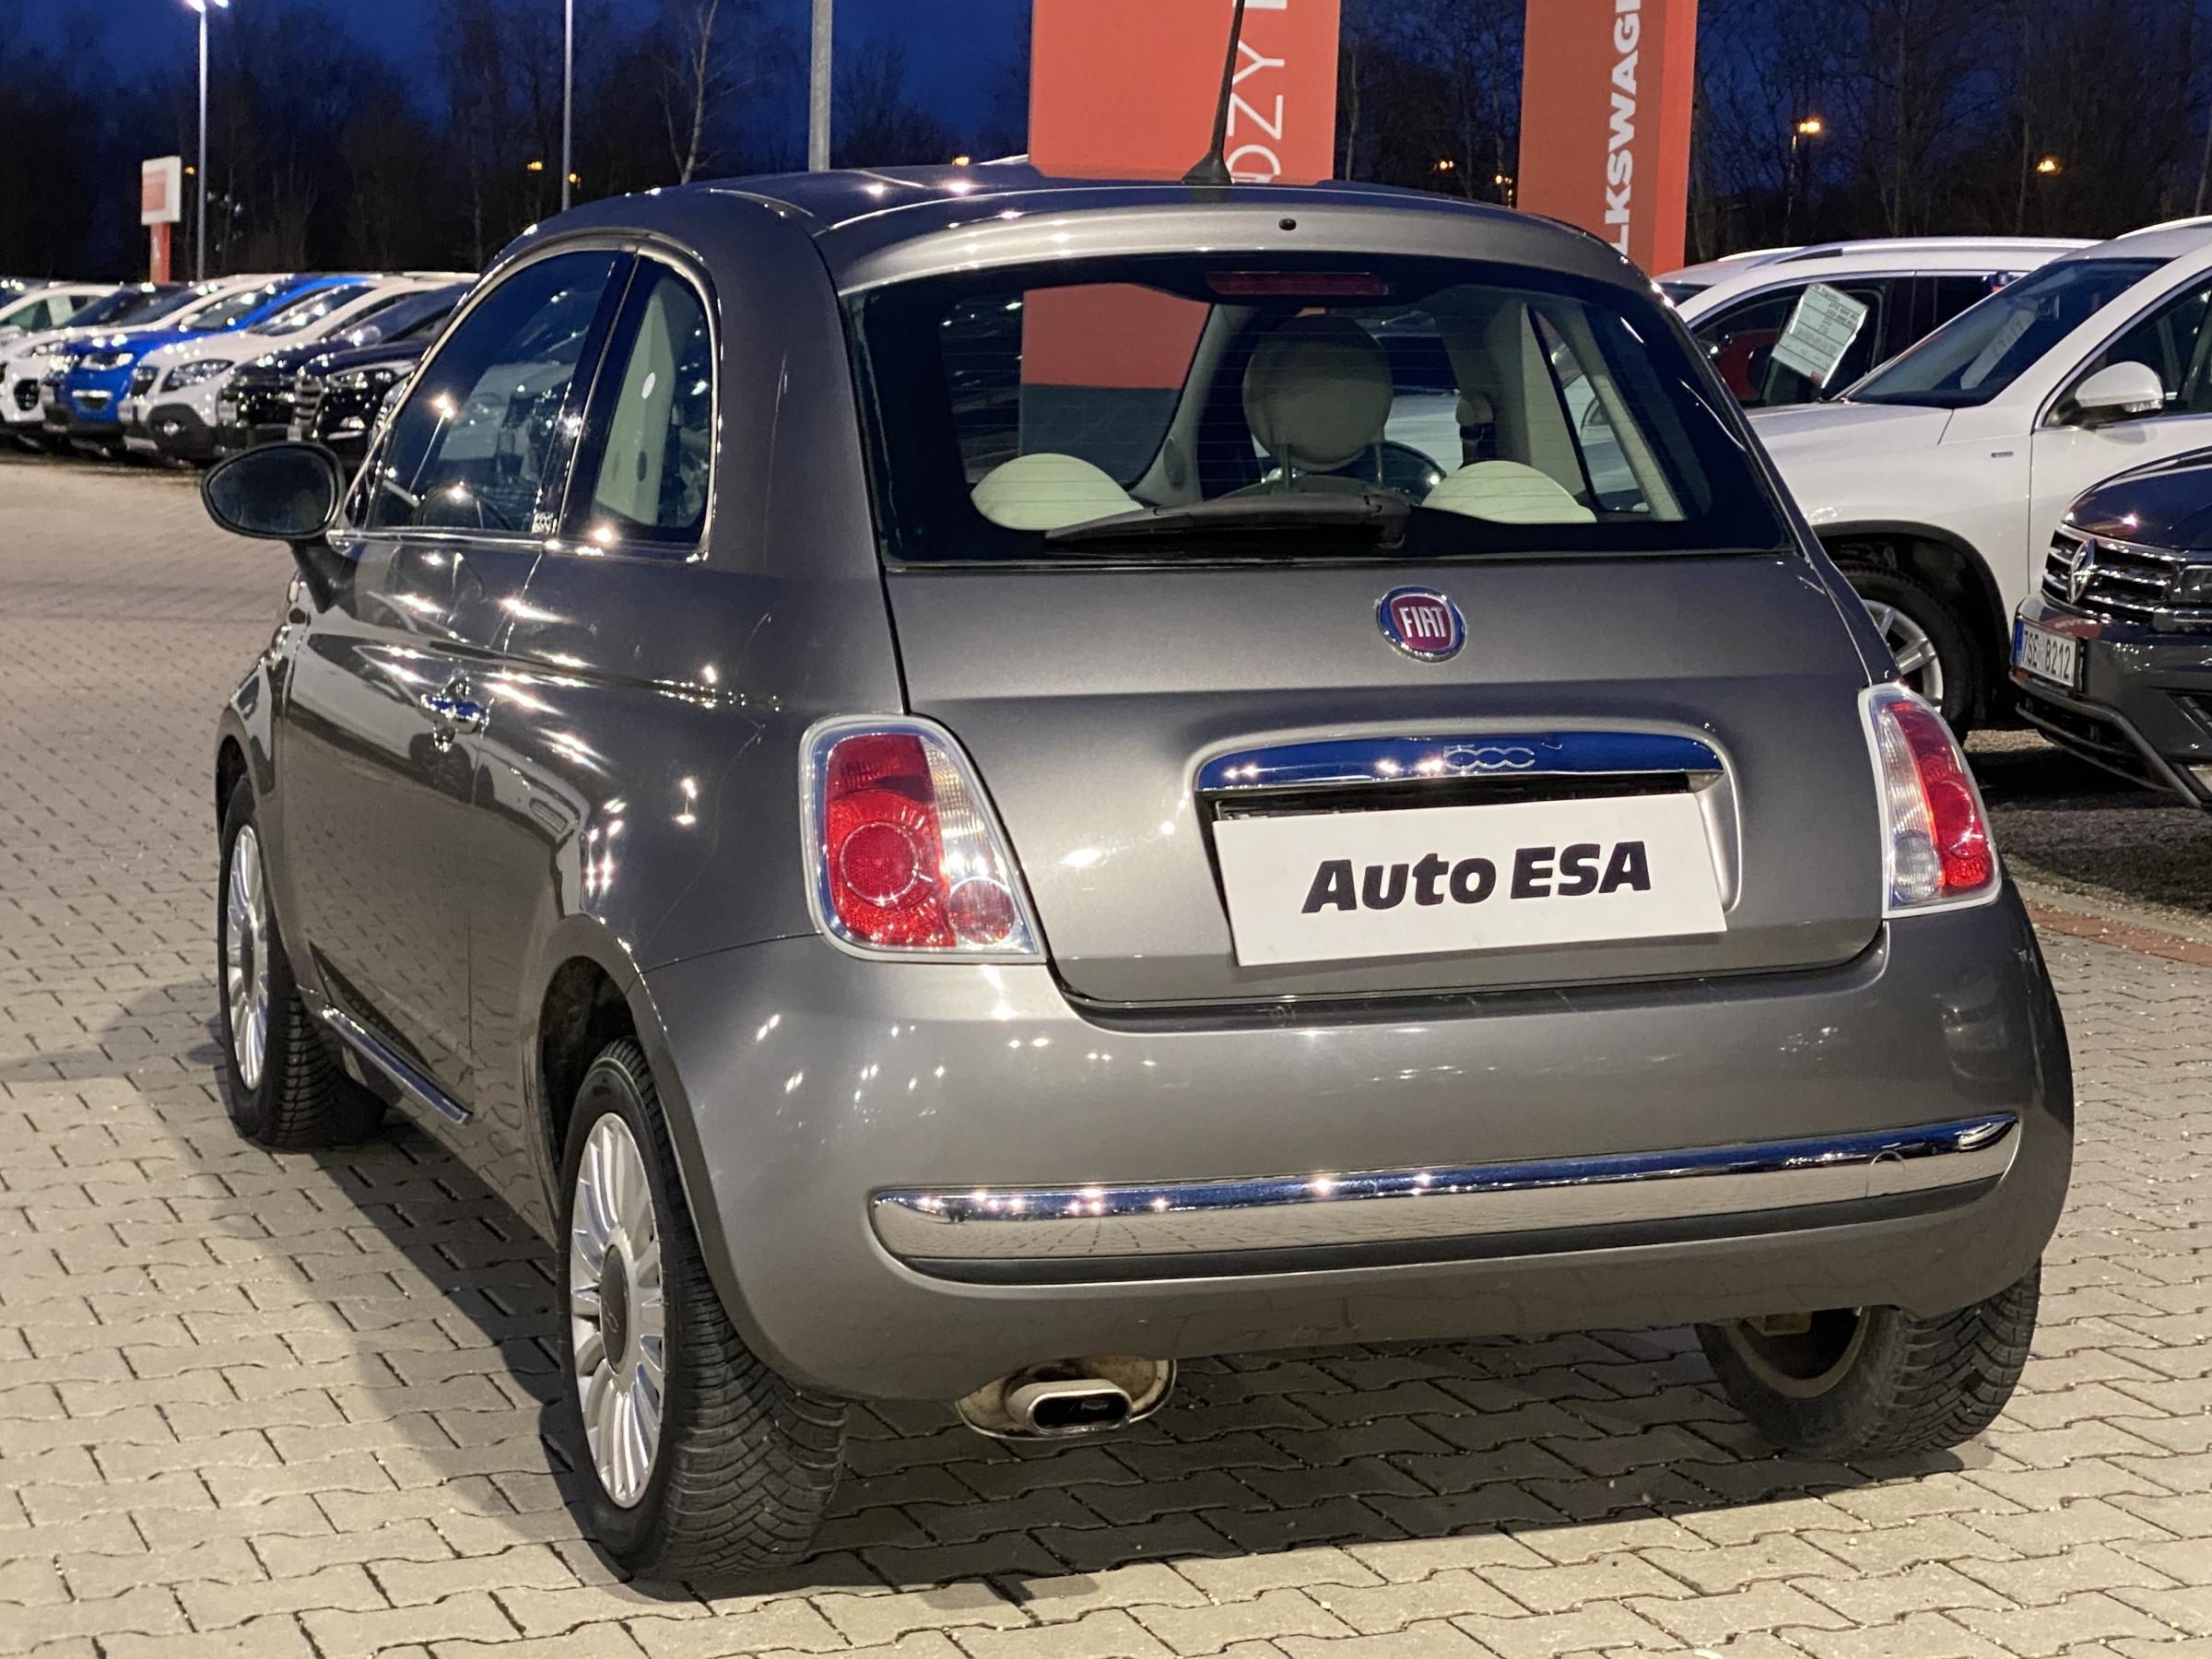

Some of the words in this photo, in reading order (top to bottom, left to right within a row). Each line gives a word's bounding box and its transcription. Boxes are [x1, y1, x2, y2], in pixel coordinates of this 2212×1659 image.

[1398, 605, 1446, 639] FIAT
[2022, 629, 2039, 668] 7SE
[2045, 638, 2071, 679] 8212
[1443, 744, 1535, 771] 500
[1300, 853, 1497, 914] Auto
[1510, 841, 1652, 900] ESA
